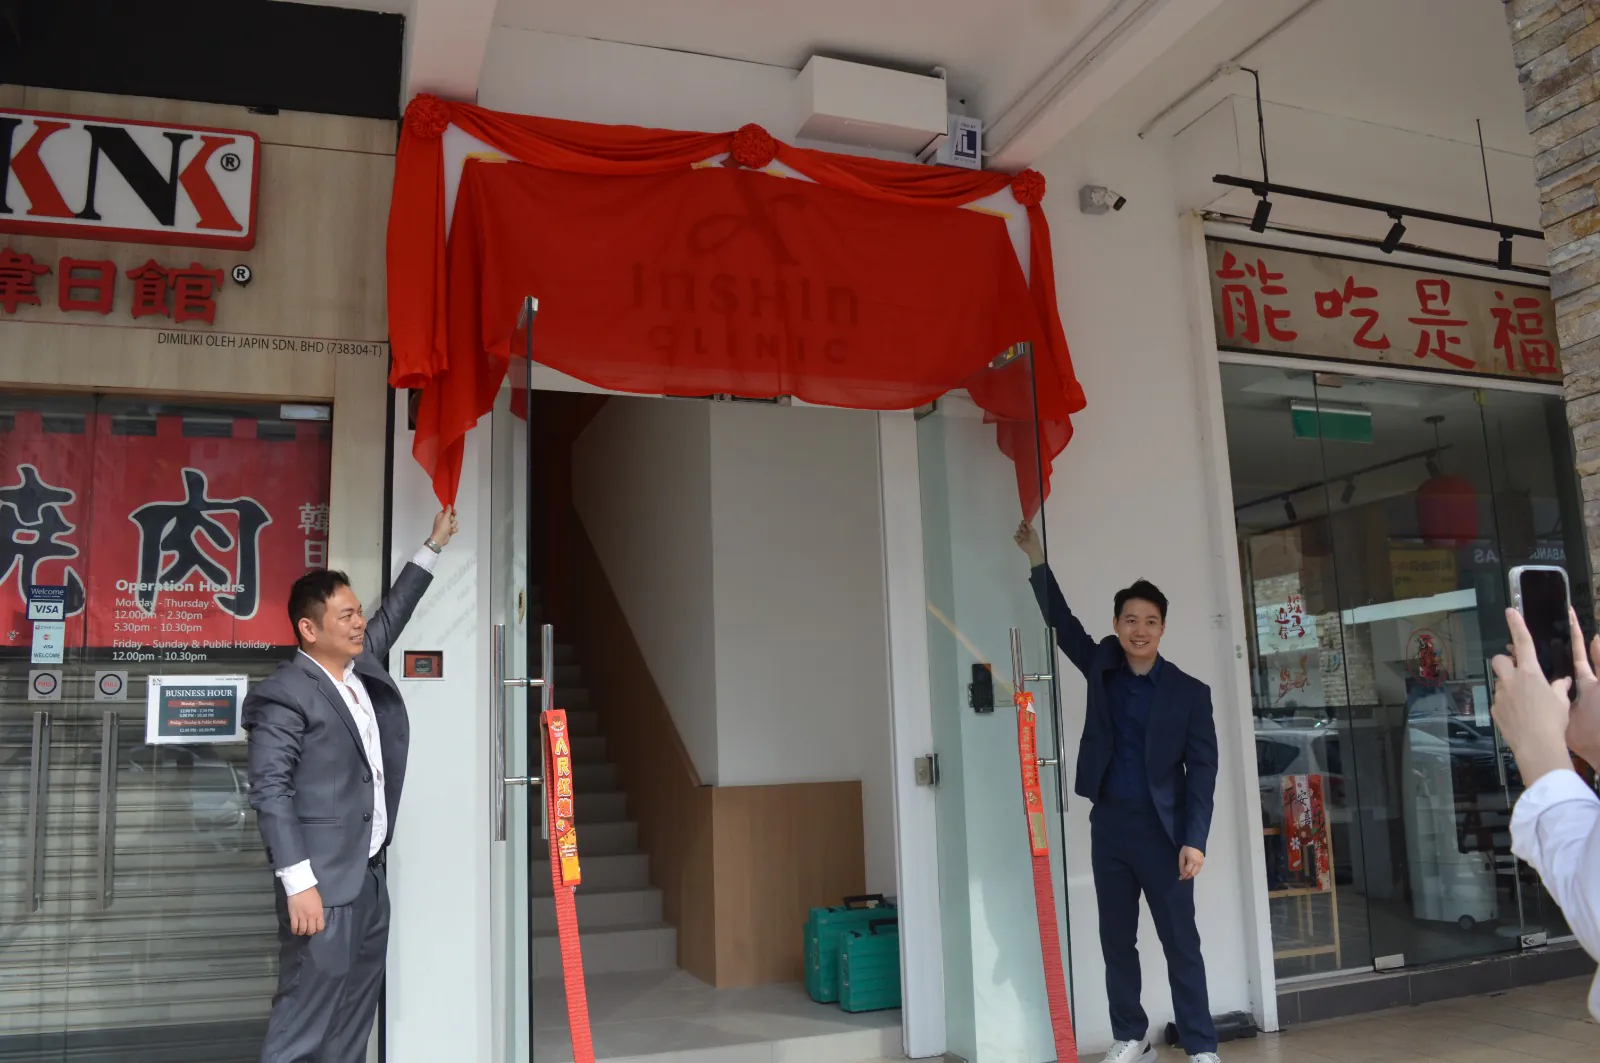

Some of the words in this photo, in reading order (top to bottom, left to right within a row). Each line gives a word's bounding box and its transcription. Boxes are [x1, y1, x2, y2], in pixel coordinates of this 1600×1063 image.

[1216, 250, 1558, 374] 能吃是福
[157, 332, 203, 346] DIMILIKI
[205, 335, 236, 348] OLEH
[237, 336, 270, 350] JAPIN
[272, 339, 298, 352] SDN.
[300, 340, 324, 353] BHD
[326, 341, 382, 358] (738304-T)
[31, 587, 64, 596] Welcome
[115, 579, 194, 594] Operation
[199, 581, 245, 593] Hours
[34, 604, 60, 614] VISA
[115, 598, 154, 609] Monday
[166, 598, 210, 609] Thursday
[115, 610, 157, 621] 12.00pm
[167, 610, 203, 621] 2.30pm
[114, 622, 151, 633] 5.30pm
[160, 623, 203, 633] 10.30pm
[113, 639, 143, 651] Friday
[152, 639, 189, 651] Sunday
[203, 639, 231, 649] Public
[234, 639, 271, 651] Holiday
[112, 651, 155, 662] 12.00pm
[165, 652, 207, 662] 10.30pm
[165, 689, 206, 697] BUSINESS
[207, 689, 233, 697] HOUR
